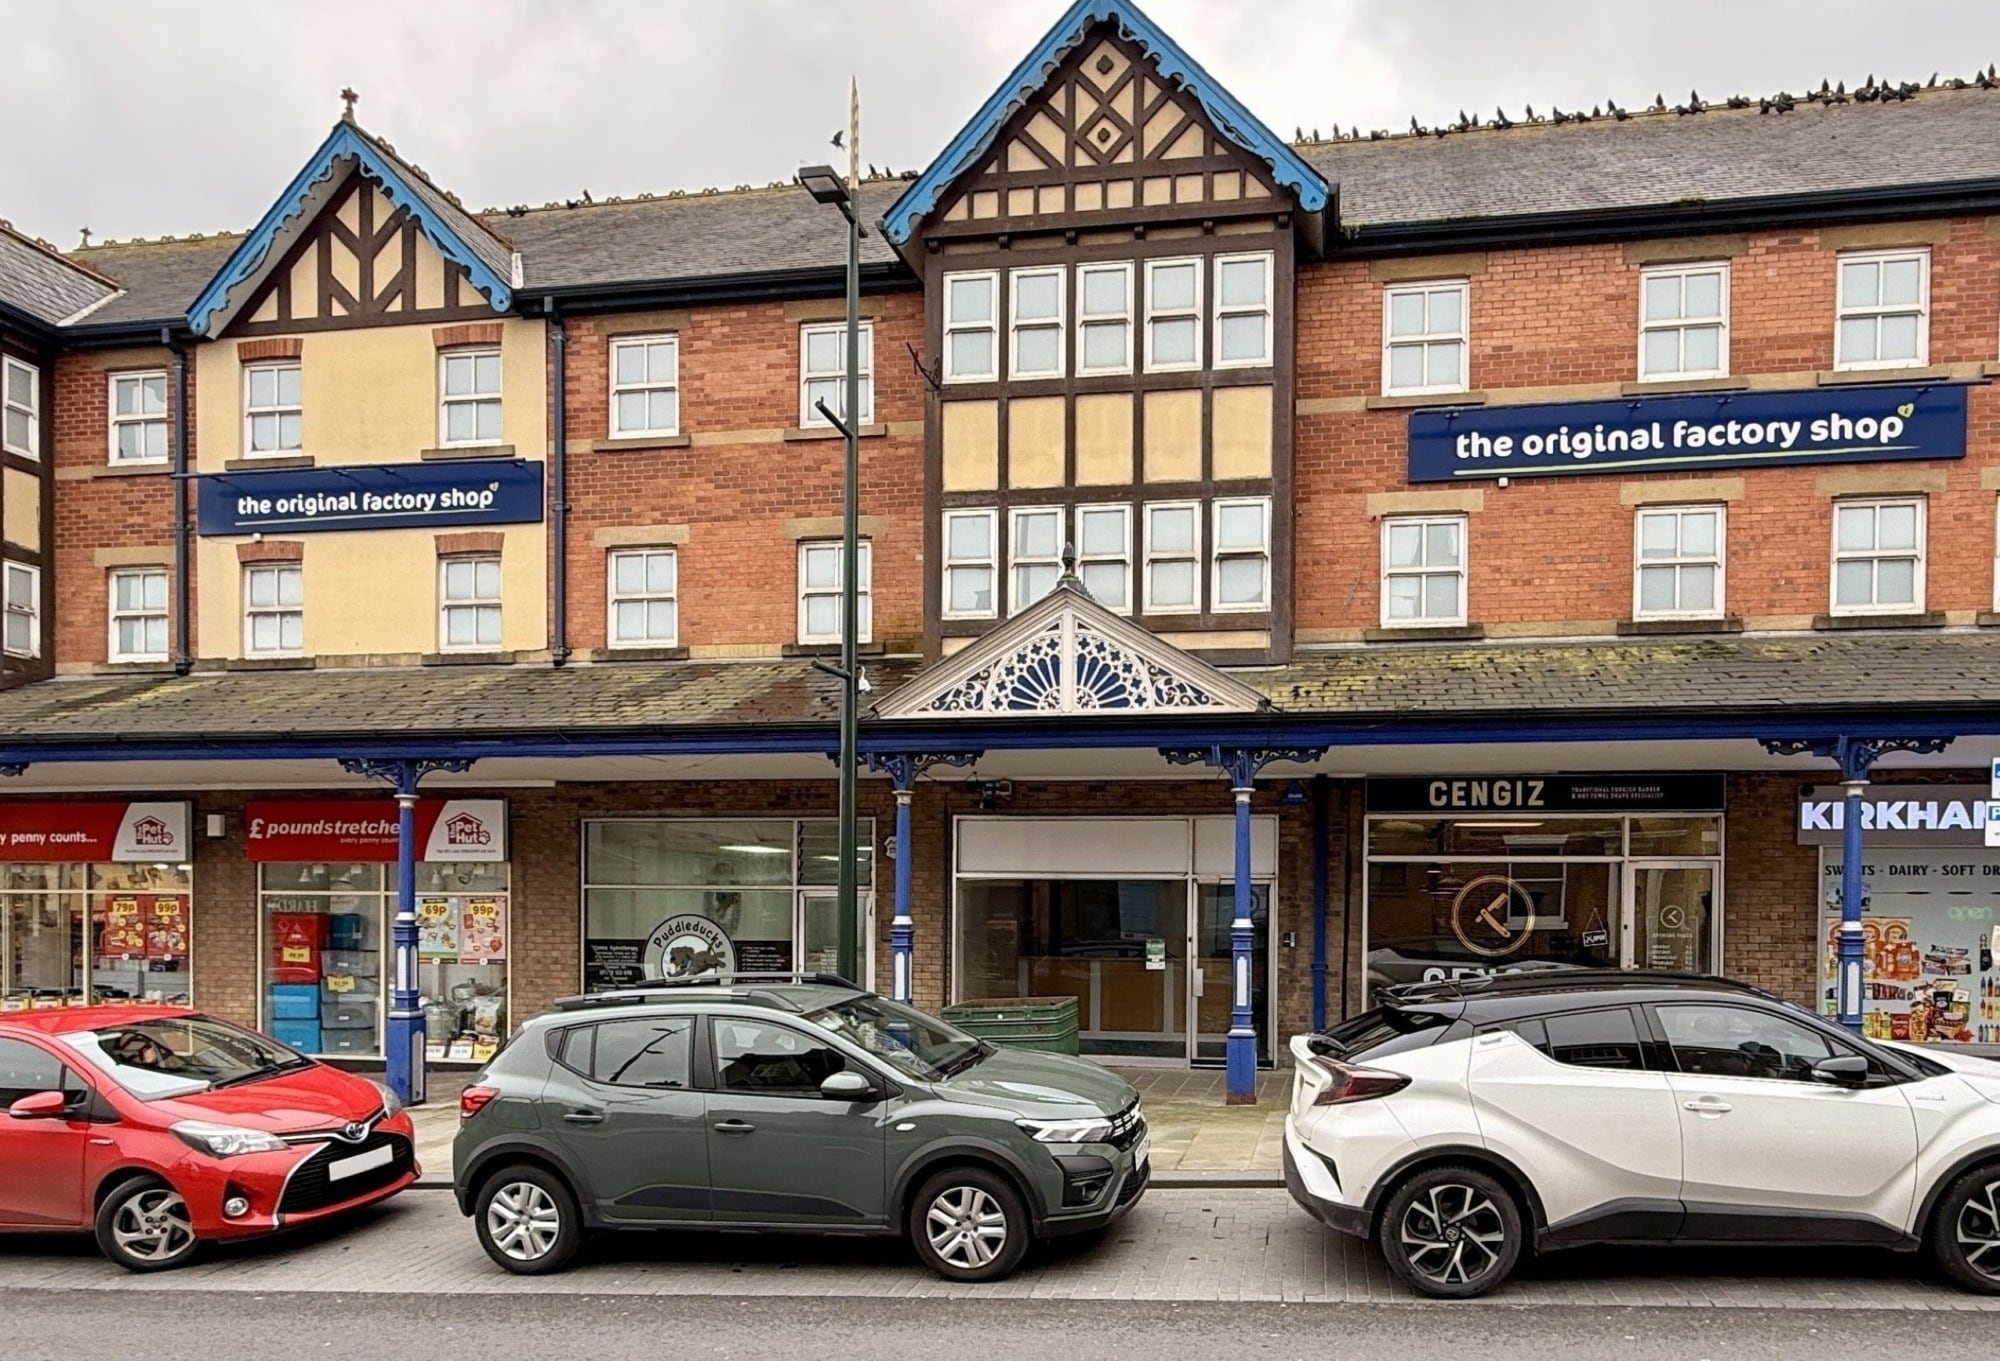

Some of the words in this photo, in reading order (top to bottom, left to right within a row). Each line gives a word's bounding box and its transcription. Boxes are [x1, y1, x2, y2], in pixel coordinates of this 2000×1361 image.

[1456, 431, 1514, 459] the
[1521, 422, 1664, 459] original
[1672, 417, 1802, 453] factory
[1809, 412, 1904, 445] shop
[237, 496, 271, 515] the
[276, 491, 357, 516] original
[362, 489, 436, 512] factory
[440, 488, 494, 509] shop
[1429, 780, 1545, 807] CENGIZ
[1801, 801, 1986, 830] KIRKHA
[142, 823, 162, 834] Pet
[266, 820, 400, 838] poundstretche
[455, 821, 478, 832] Pet
[11, 833, 46, 846] penny
[50, 831, 98, 843] counts...
[142, 834, 162, 844] Hut
[455, 832, 478, 843] Hut
[1824, 864, 1875, 876] SWTS
[1888, 864, 1929, 876] DAIRY
[1941, 864, 1976, 876] SOFT
[115, 903, 135, 914] 79p
[157, 903, 177, 913] 99p
[425, 905, 447, 916] 69p
[472, 905, 494, 916] 99p
[1948, 906, 1992, 920] open
[653, 921, 723, 949] Puddleducks
